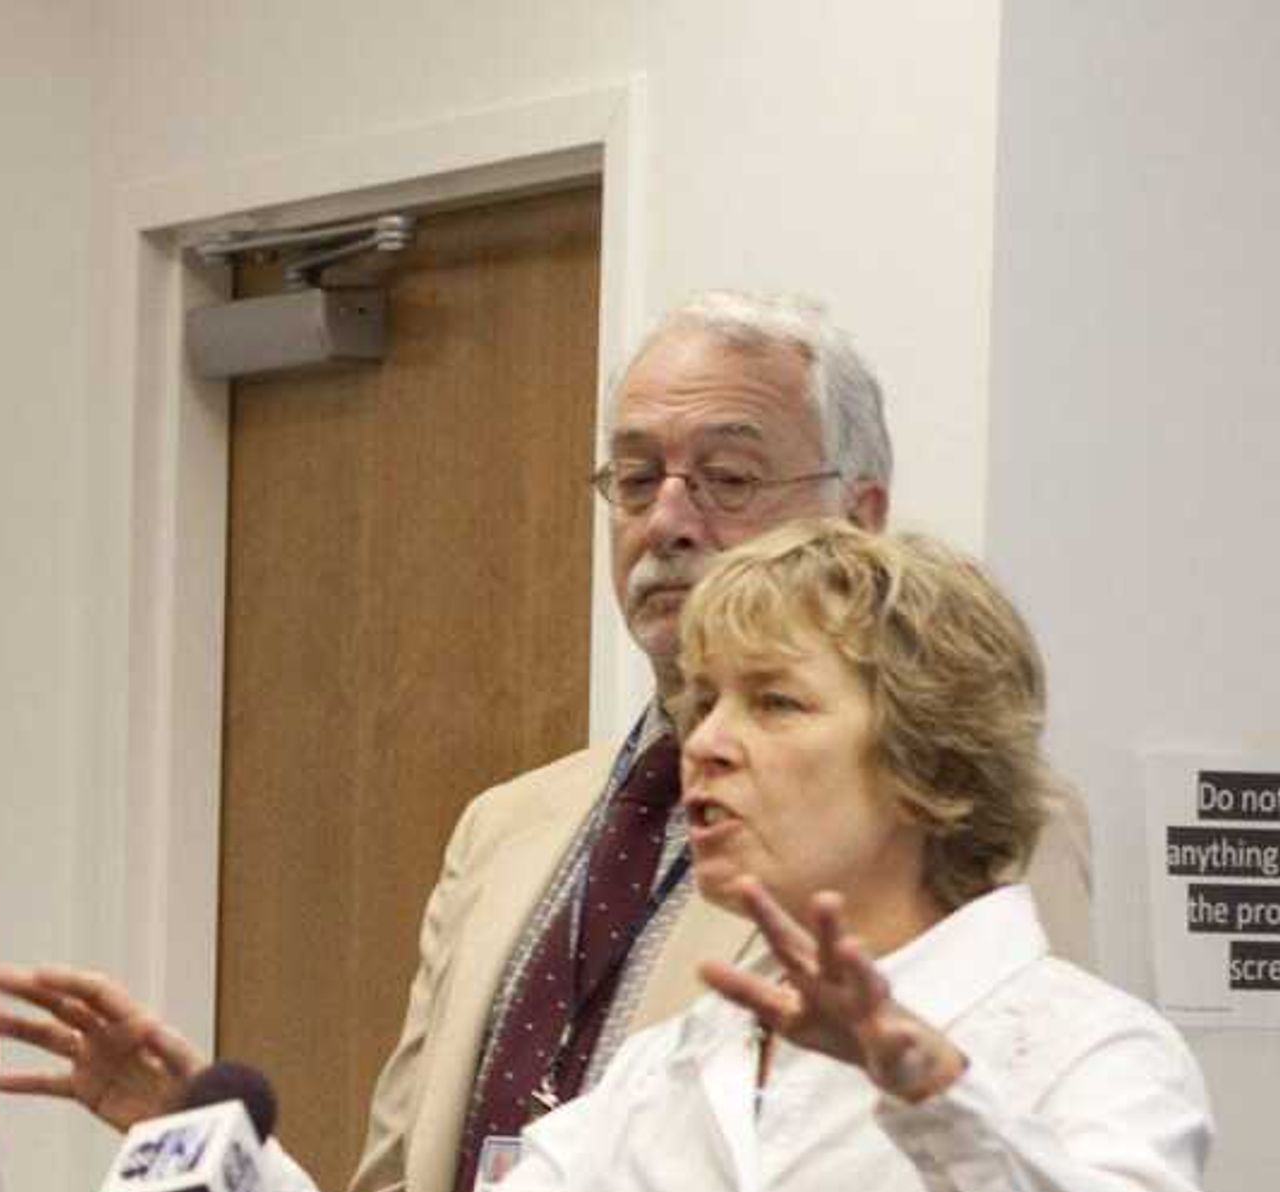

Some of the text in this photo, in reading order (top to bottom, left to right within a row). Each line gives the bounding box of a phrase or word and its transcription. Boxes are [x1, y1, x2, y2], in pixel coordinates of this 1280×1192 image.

[1200, 781, 1234, 811] Do
[1167, 837, 1279, 875] anything
[1189, 893, 1280, 930] the pro
